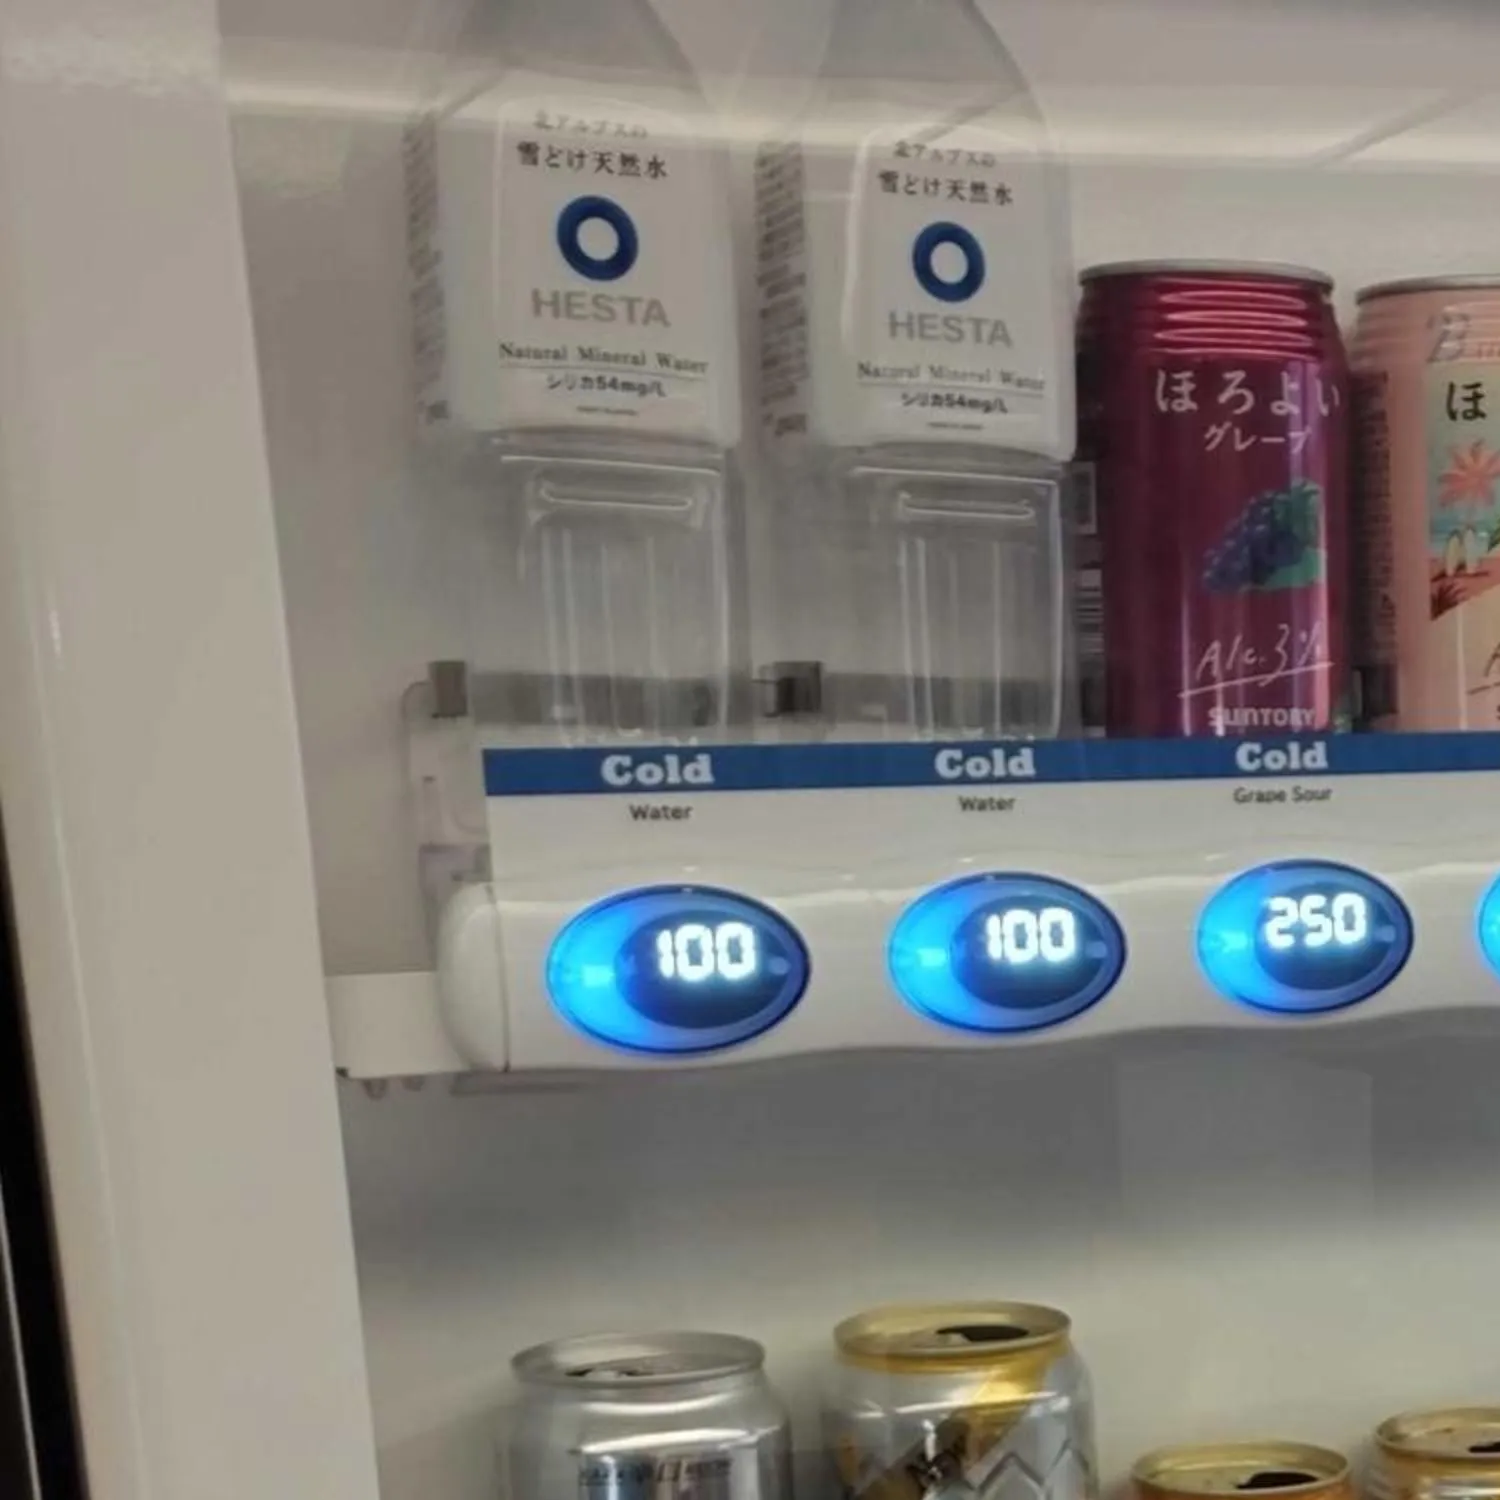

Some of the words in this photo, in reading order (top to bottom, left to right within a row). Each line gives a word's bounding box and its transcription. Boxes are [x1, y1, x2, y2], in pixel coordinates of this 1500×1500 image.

[517, 142, 667, 179] 雪どけ天然水
[878, 170, 1013, 205] 雪どけ天然水
[531, 289, 670, 329] HESTA
[888, 311, 1012, 349] HESTA
[500, 341, 567, 362] Natural
[575, 345, 646, 367] Mineral
[656, 350, 707, 373] Water
[858, 362, 920, 382] Natural
[928, 364, 991, 386] Mineral
[999, 370, 1045, 391] Water
[1156, 369, 1340, 417] ほろよい
[1204, 421, 1312, 453] グレープ
[1209, 707, 1317, 728] SUNTORY
[602, 752, 714, 787] Cold
[935, 748, 1035, 781] Cold
[1235, 742, 1328, 774] Cold
[959, 795, 1015, 812] Water
[1234, 787, 1288, 805] Grape
[1292, 785, 1332, 802] Sour
[630, 804, 692, 821] Water
[985, 907, 1076, 963] 100
[1263, 891, 1368, 948] 250
[655, 921, 757, 982] 100
